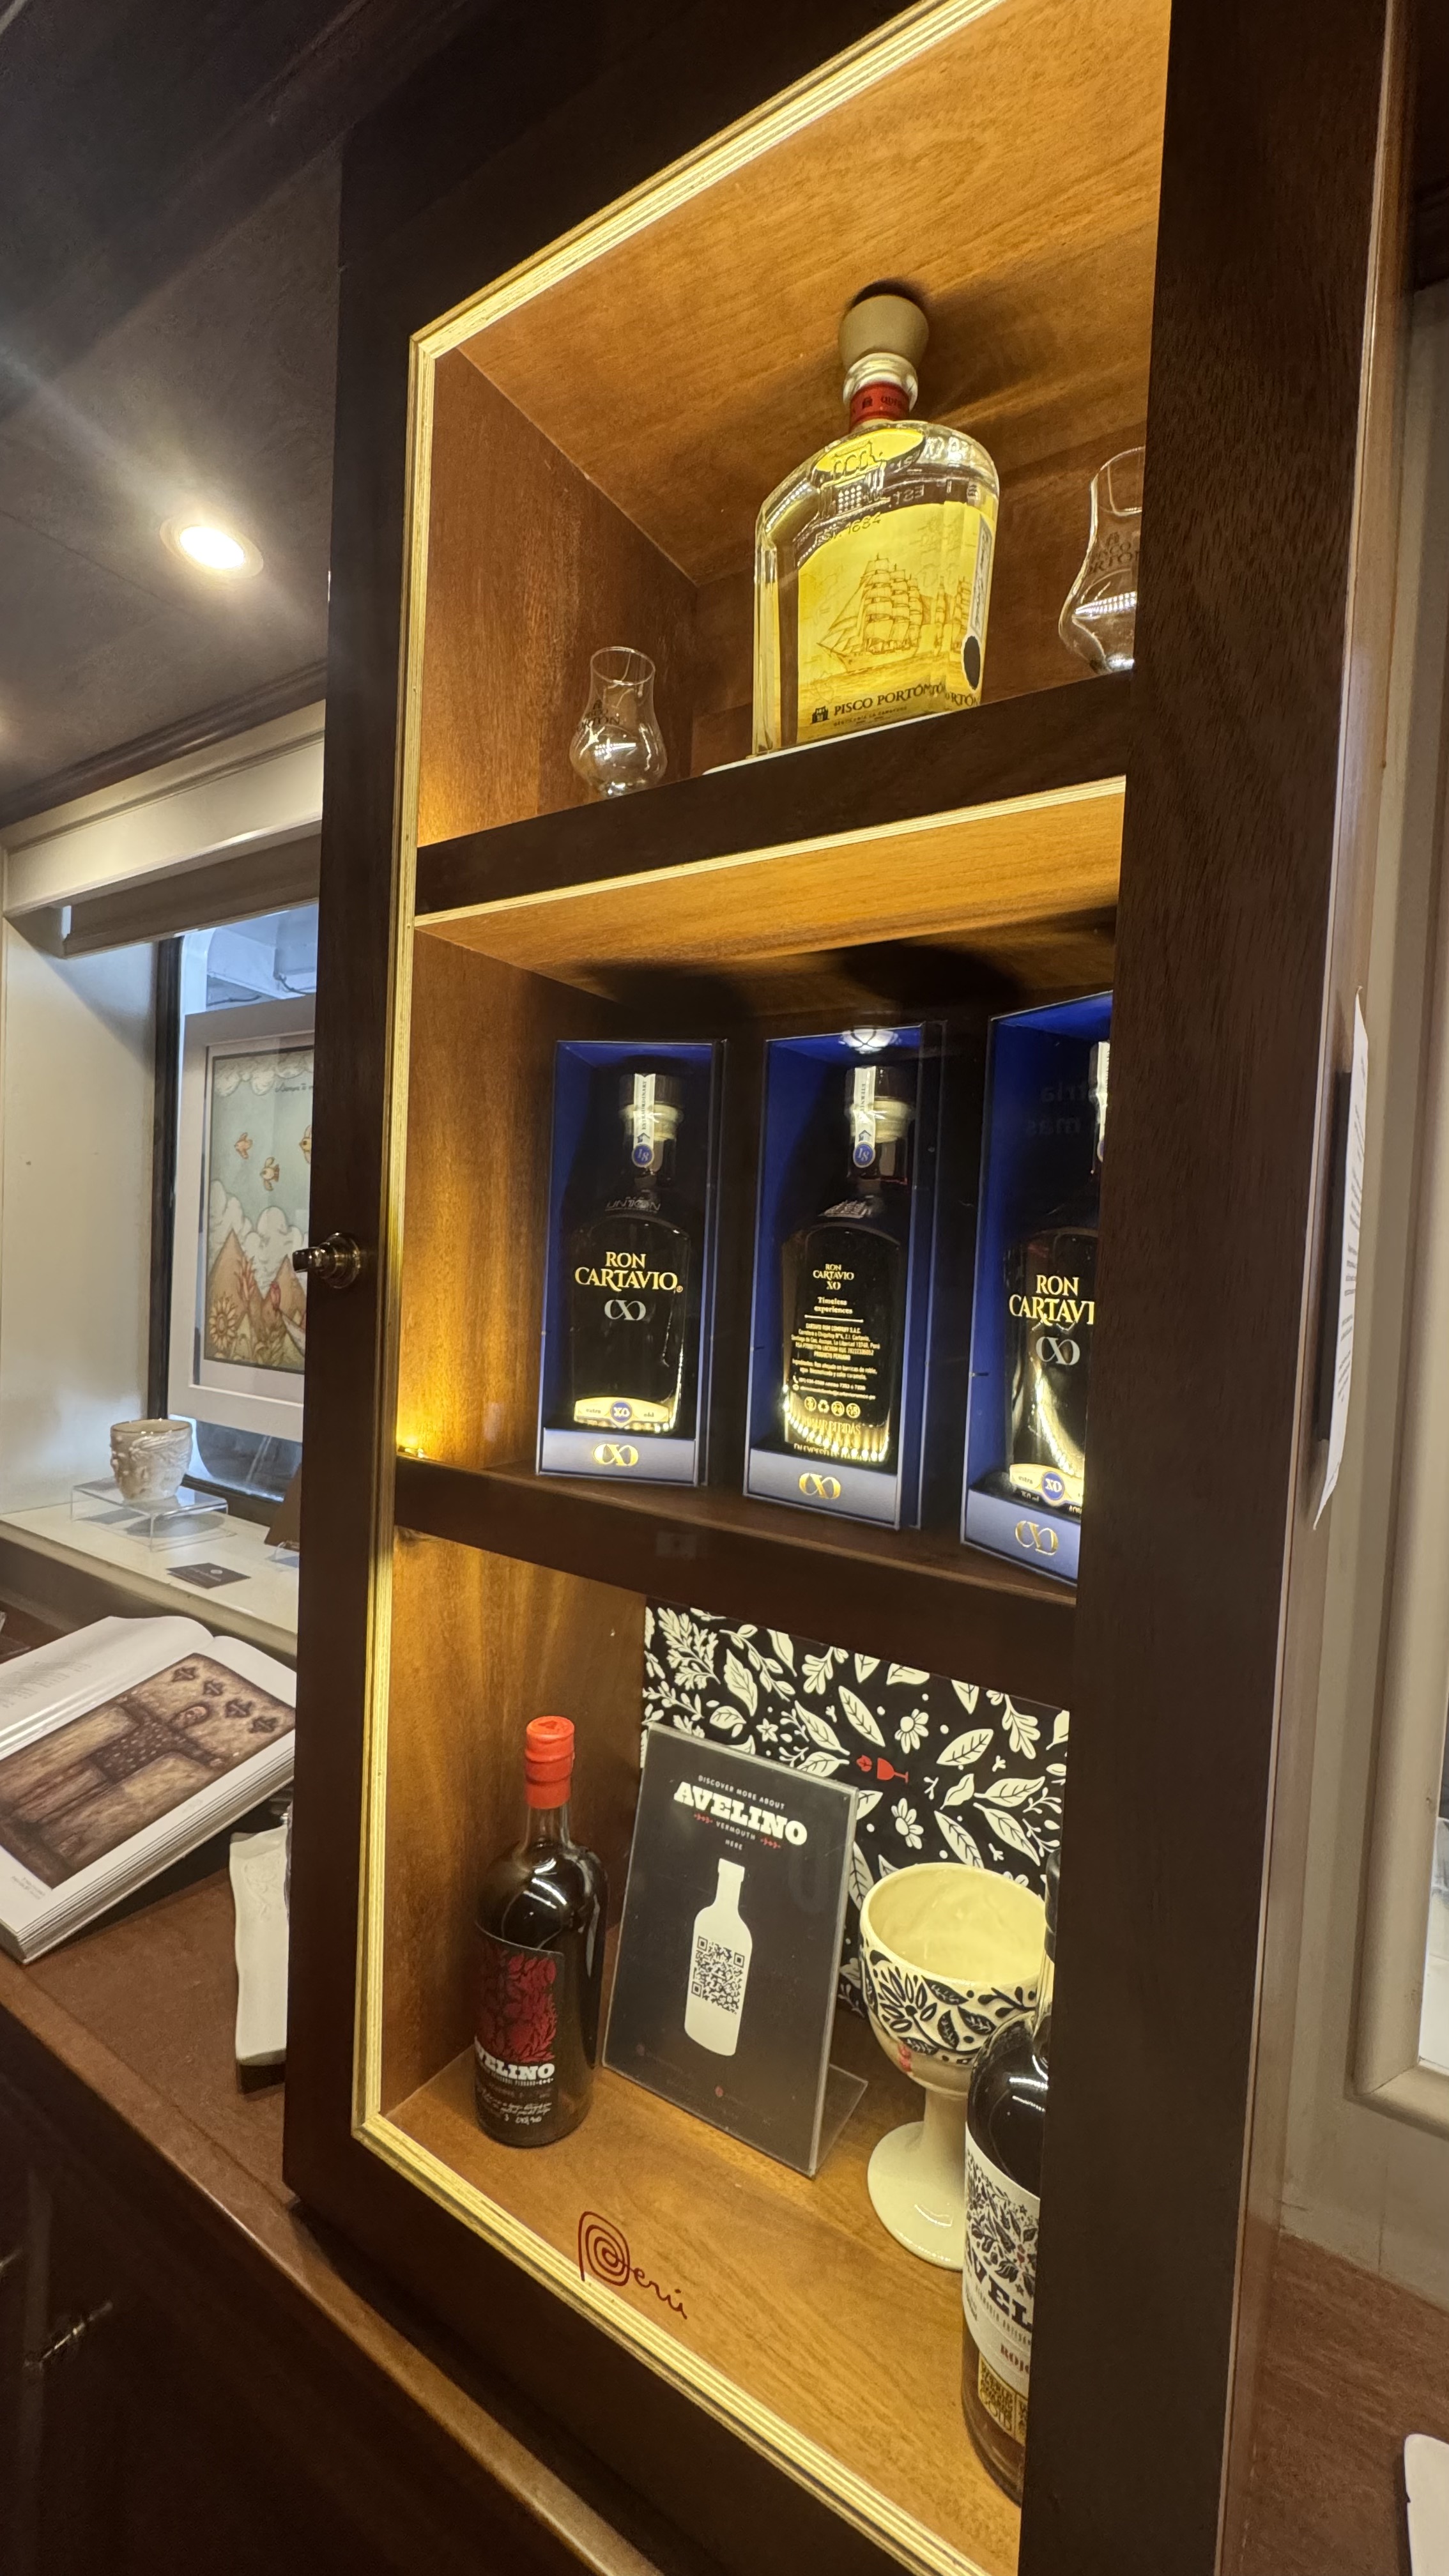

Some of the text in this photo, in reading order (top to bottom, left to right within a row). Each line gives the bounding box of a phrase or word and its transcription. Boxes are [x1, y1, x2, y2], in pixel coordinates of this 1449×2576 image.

[833, 698, 873, 716] PISCO
[605, 1251, 647, 1269] RON
[575, 1266, 678, 1292] CARTAVIO
[813, 1269, 855, 1281] CARTAVIO
[826, 1281, 841, 1291] XO
[1036, 1275, 1080, 1297] RON
[817, 1296, 848, 1305] Timeless
[813, 1306, 853, 1314] experiences
[1009, 1294, 1095, 1326] CARTAVI
[613, 1407, 630, 1418] XO
[1045, 1478, 1062, 1492] XO
[698, 1775, 785, 1809] DISCOVER MORE ABOUT
[673, 1781, 808, 1846] AVELINO
[716, 1821, 756, 1841] VERMOUTH
[724, 1839, 743, 1850] HERE
[474, 2037, 555, 2080] VELINO
